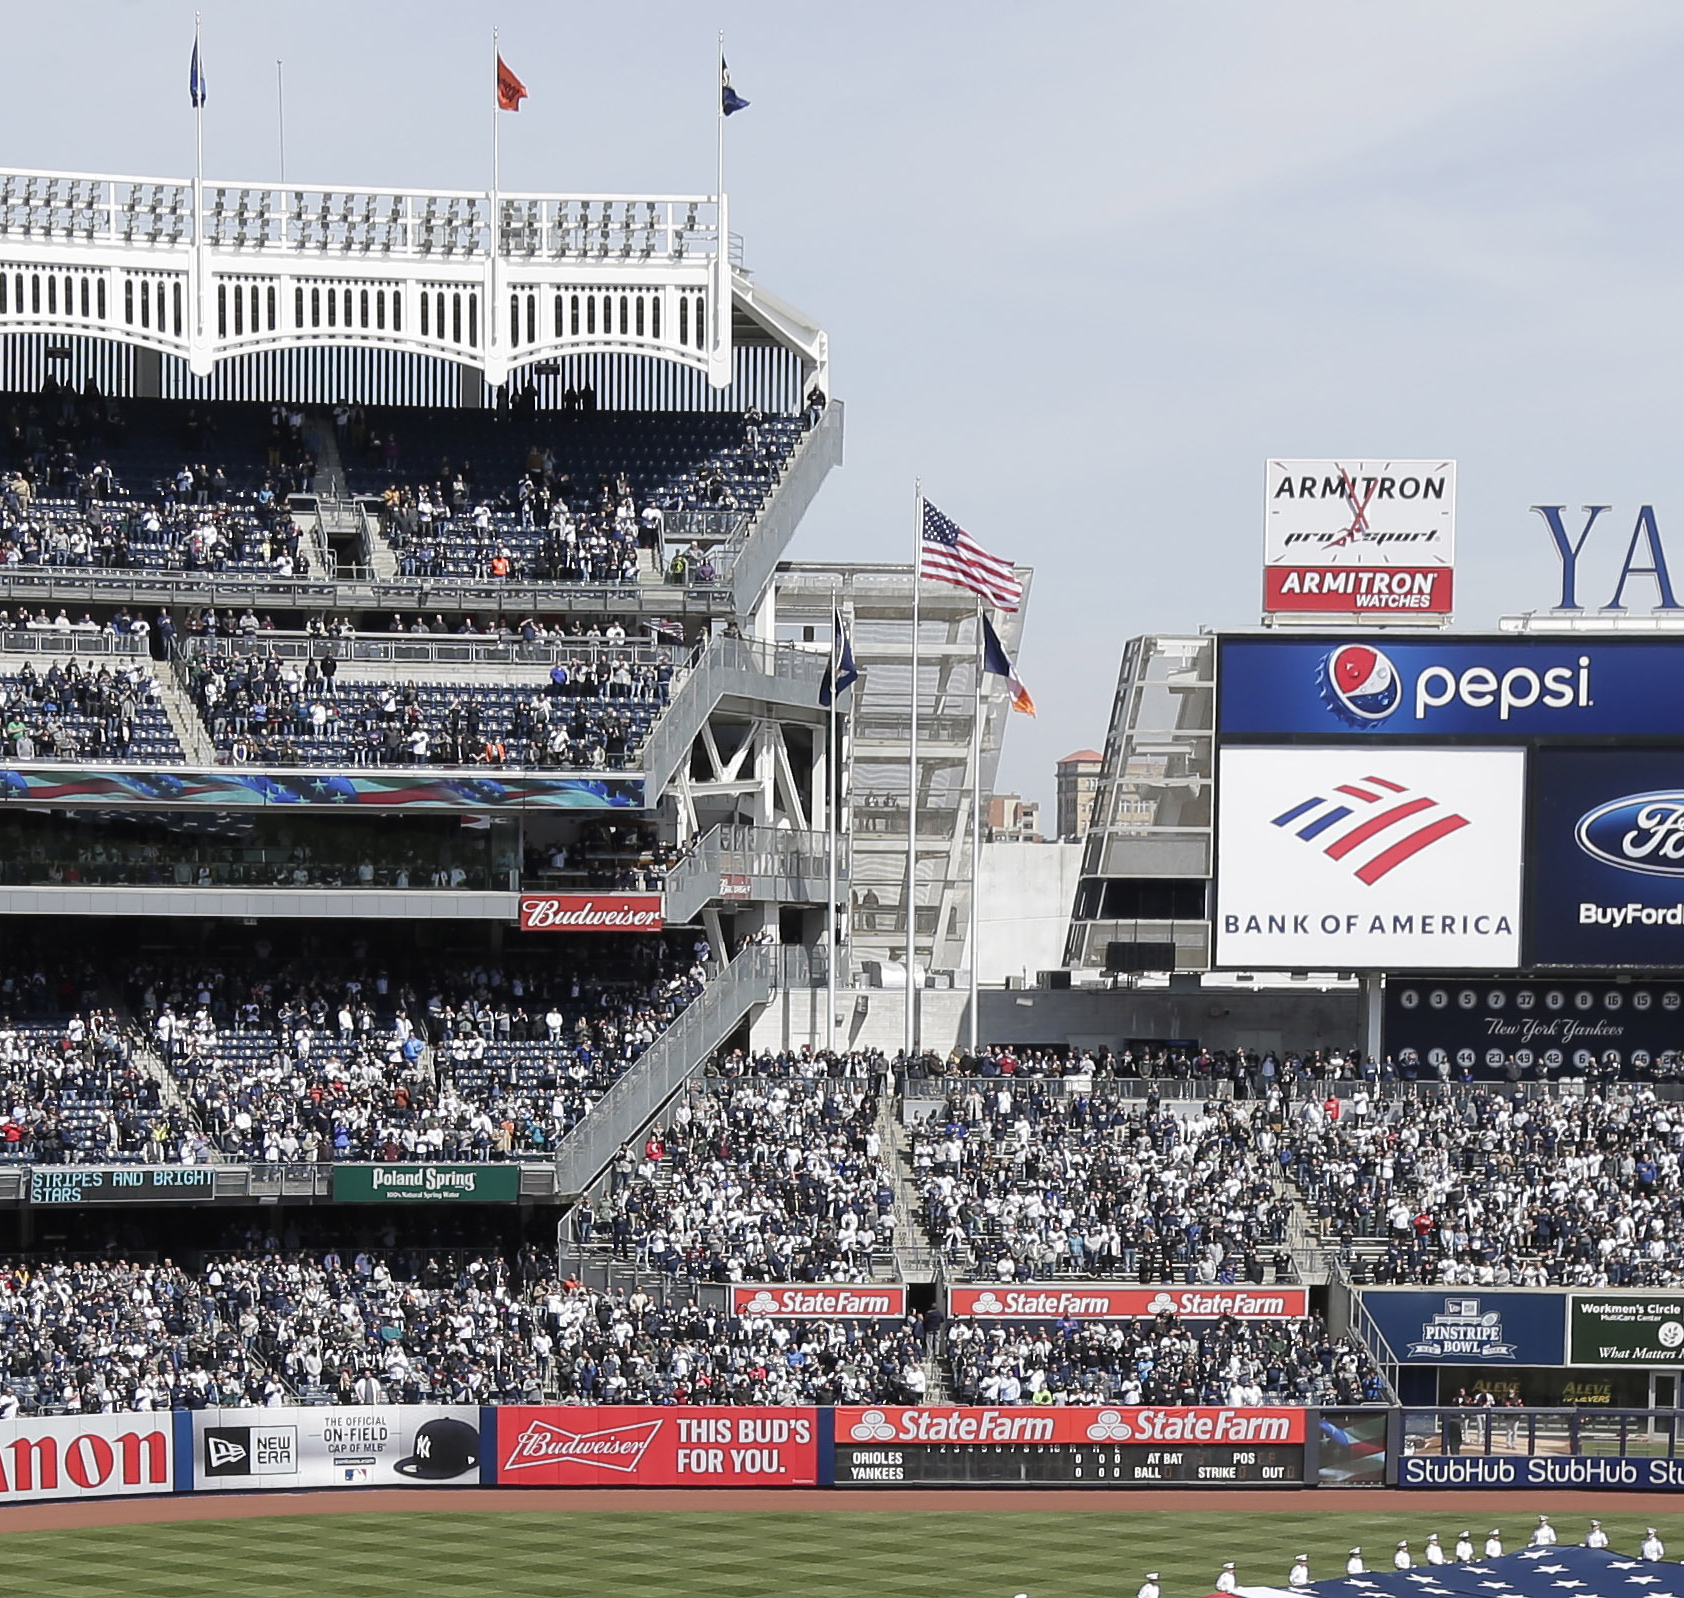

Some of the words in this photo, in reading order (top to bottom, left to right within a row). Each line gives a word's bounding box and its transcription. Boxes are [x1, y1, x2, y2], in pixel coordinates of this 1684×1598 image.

[1274, 474, 1446, 502] ARMITRON
[1279, 570, 1438, 596] ARMITRON
[1355, 592, 1432, 609] WATCHES
[1414, 656, 1594, 721] pepsi
[522, 899, 661, 927] Budweiser
[1224, 914, 1311, 937] BANK
[1320, 914, 1361, 936] OF
[1367, 914, 1514, 937] AMERICA
[1484, 1017, 1520, 1035] New
[1521, 1018, 1560, 1044] York
[1561, 1018, 1624, 1044] Yankees
[32, 1171, 102, 1188] STRIPES
[112, 1171, 144, 1187] AND
[152, 1170, 214, 1187] BRIGHT
[372, 1168, 424, 1190] Poland
[425, 1167, 476, 1192] Spring
[32, 1187, 82, 1203] STARS
[1581, 1304, 1645, 1314] Workmen's
[1647, 1304, 1681, 1314] Circle
[1425, 1325, 1500, 1341] PINSTRIPE
[1443, 1341, 1481, 1353] BOWL
[1599, 1346, 1630, 1359] What
[1632, 1347, 1677, 1360] Matters
[324, 1417, 342, 1427] THE
[345, 1416, 387, 1427] OFFICIAL
[323, 1427, 388, 1443] ON-FIELD
[676, 1419, 732, 1444] THIS
[738, 1418, 811, 1444] BUD'S
[257, 1435, 291, 1450] NEW
[328, 1444, 347, 1453] CAP
[349, 1444, 361, 1453] OF
[518, 1430, 647, 1457] Budweiser
[257, 1451, 291, 1464] ERA
[677, 1448, 725, 1474] FOR
[730, 1448, 786, 1474] YOU.
[852, 1452, 903, 1465] ORIOLES
[1147, 1453, 1162, 1464] AT
[1163, 1453, 1184, 1464] BAT
[1233, 1453, 1256, 1464] POS
[851, 1467, 904, 1480] YANKEES
[1134, 1467, 1162, 1479] BALL
[1198, 1467, 1237, 1479] STRIKE
[1262, 1467, 1285, 1479] OUT
[1406, 1458, 1515, 1484] StubHub
[1526, 1459, 1637, 1485] StubHub
